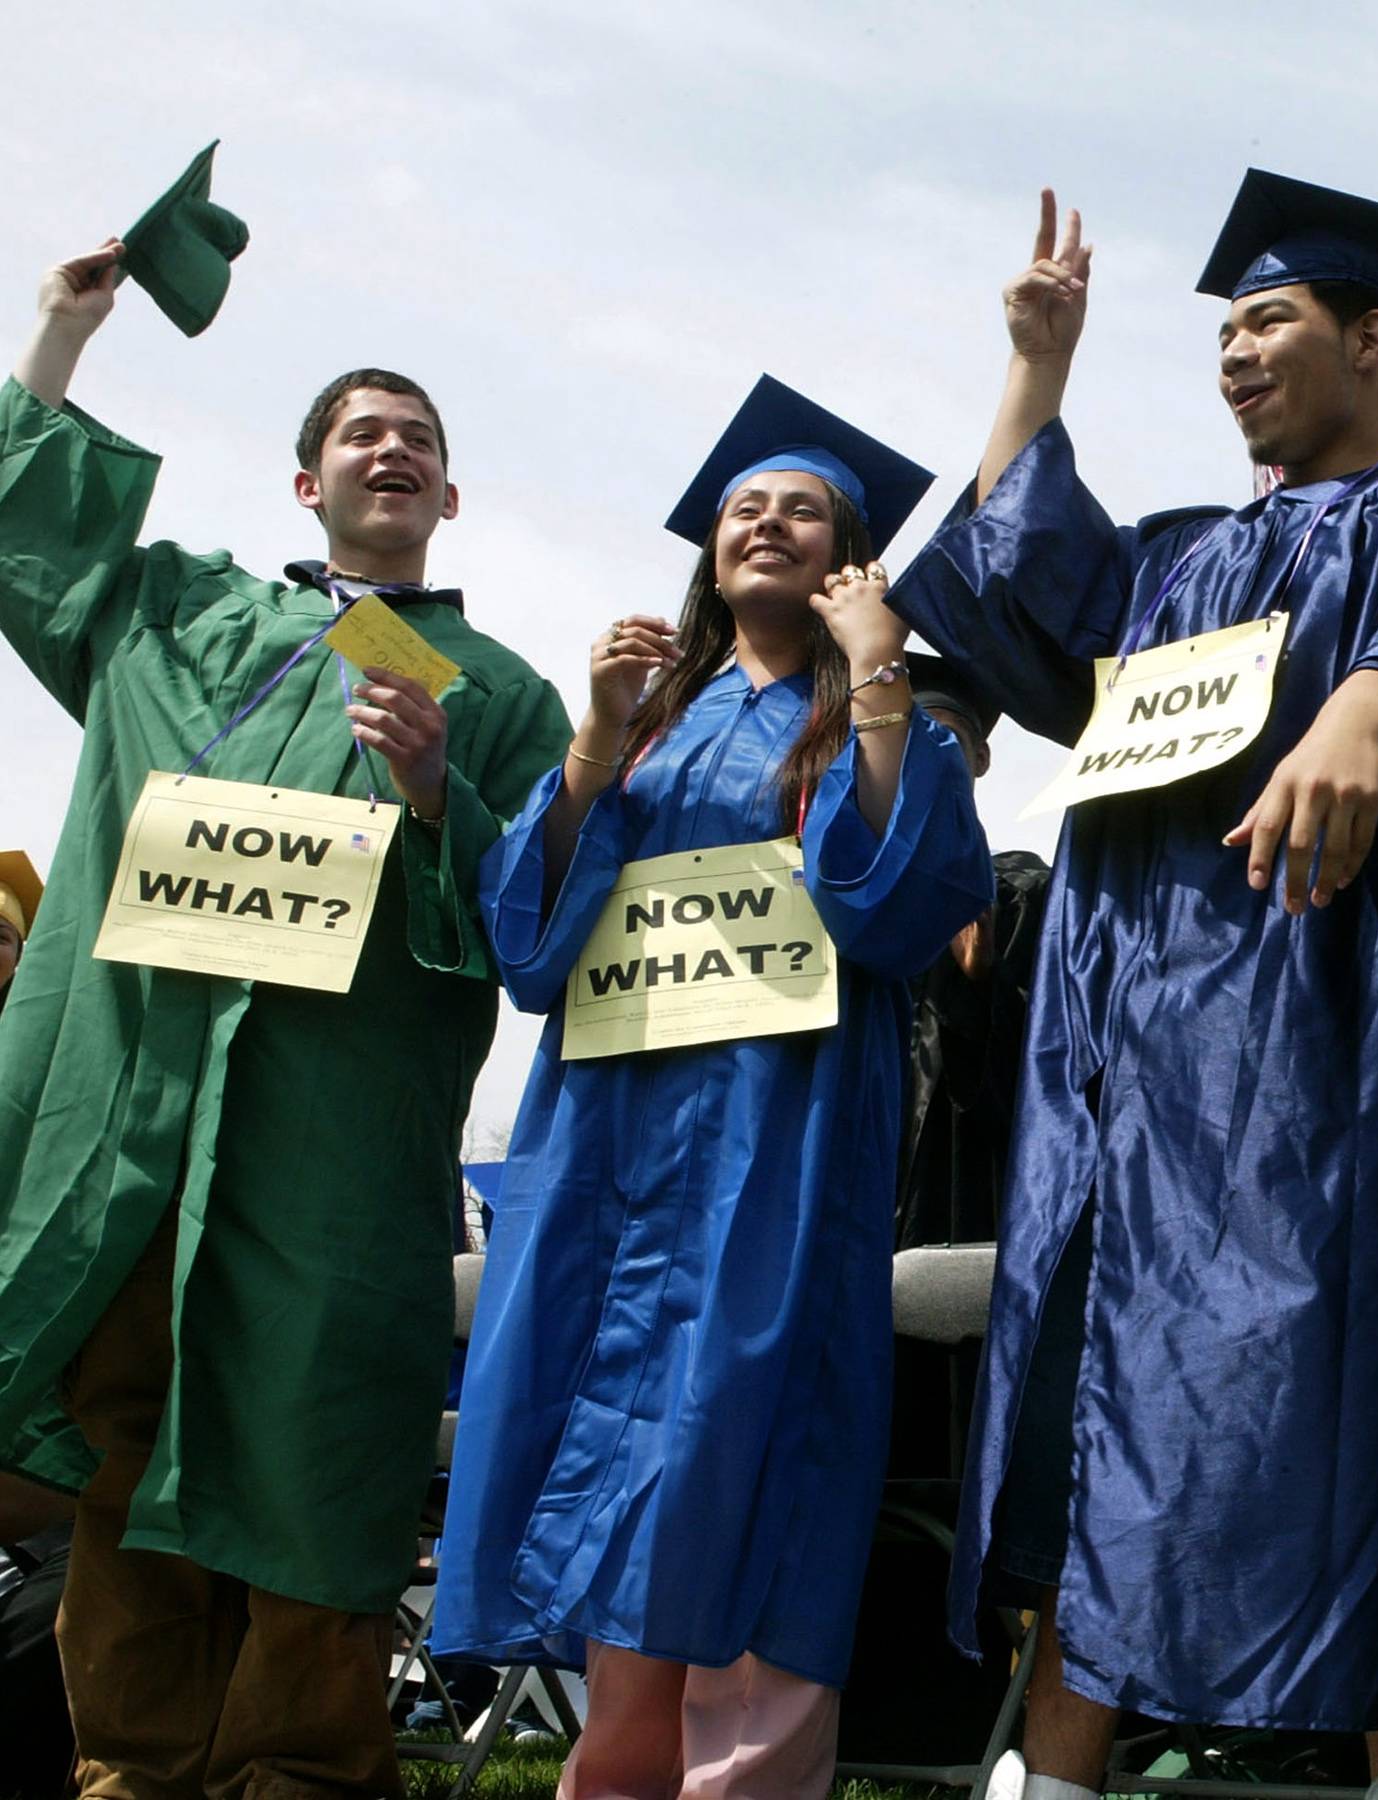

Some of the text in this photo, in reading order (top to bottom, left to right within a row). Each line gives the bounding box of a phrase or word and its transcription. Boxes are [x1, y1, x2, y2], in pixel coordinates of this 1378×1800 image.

[1128, 673, 1239, 724] NOW
[1077, 727, 1245, 776] WHAT?
[186, 819, 334, 867] NOW
[138, 871, 352, 929] WHAT?
[625, 887, 775, 934] NOW
[587, 941, 813, 996] WHAT?
